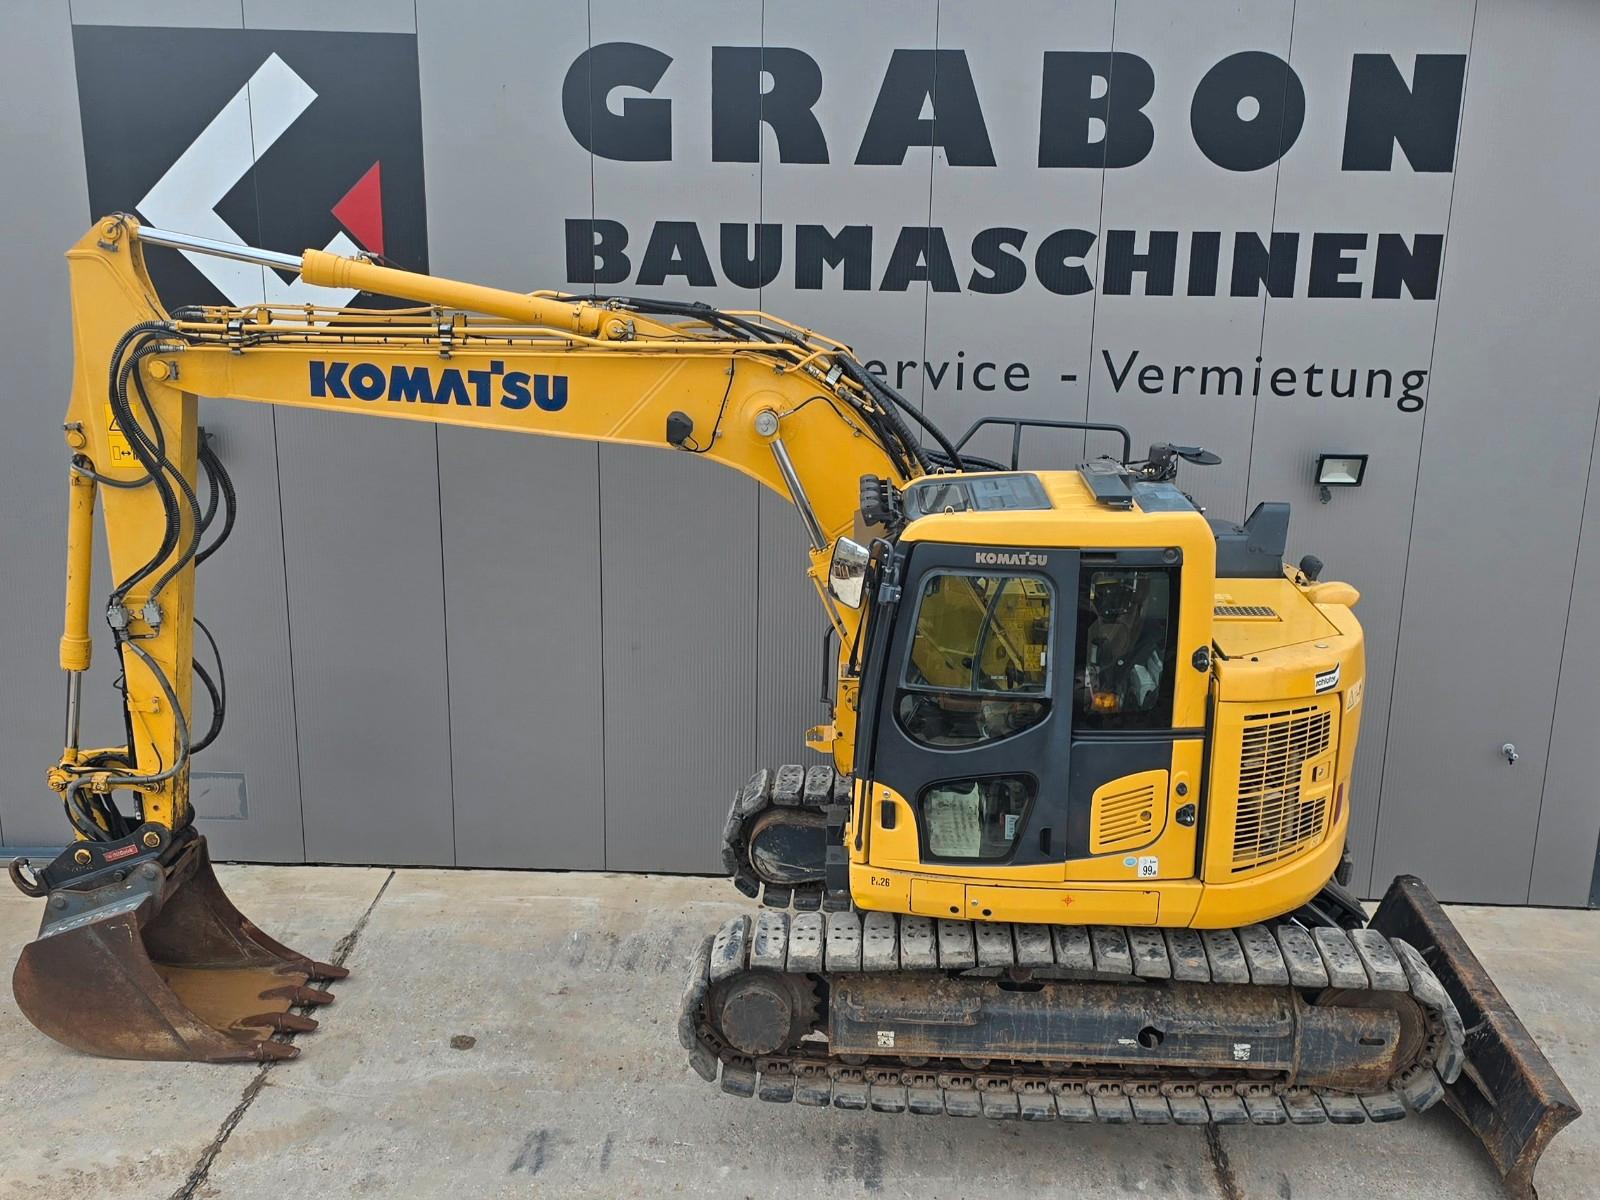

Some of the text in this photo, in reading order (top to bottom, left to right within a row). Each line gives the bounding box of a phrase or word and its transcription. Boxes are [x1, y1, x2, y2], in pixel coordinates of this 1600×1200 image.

[562, 41, 1467, 173] GRABON
[565, 218, 1444, 300] BAUMASCHINEN
[309, 360, 568, 412] KOMATSU
[864, 350, 1030, 392] ervice
[1102, 350, 1428, 413] Vermietung
[975, 551, 1048, 566] KOMATSU
